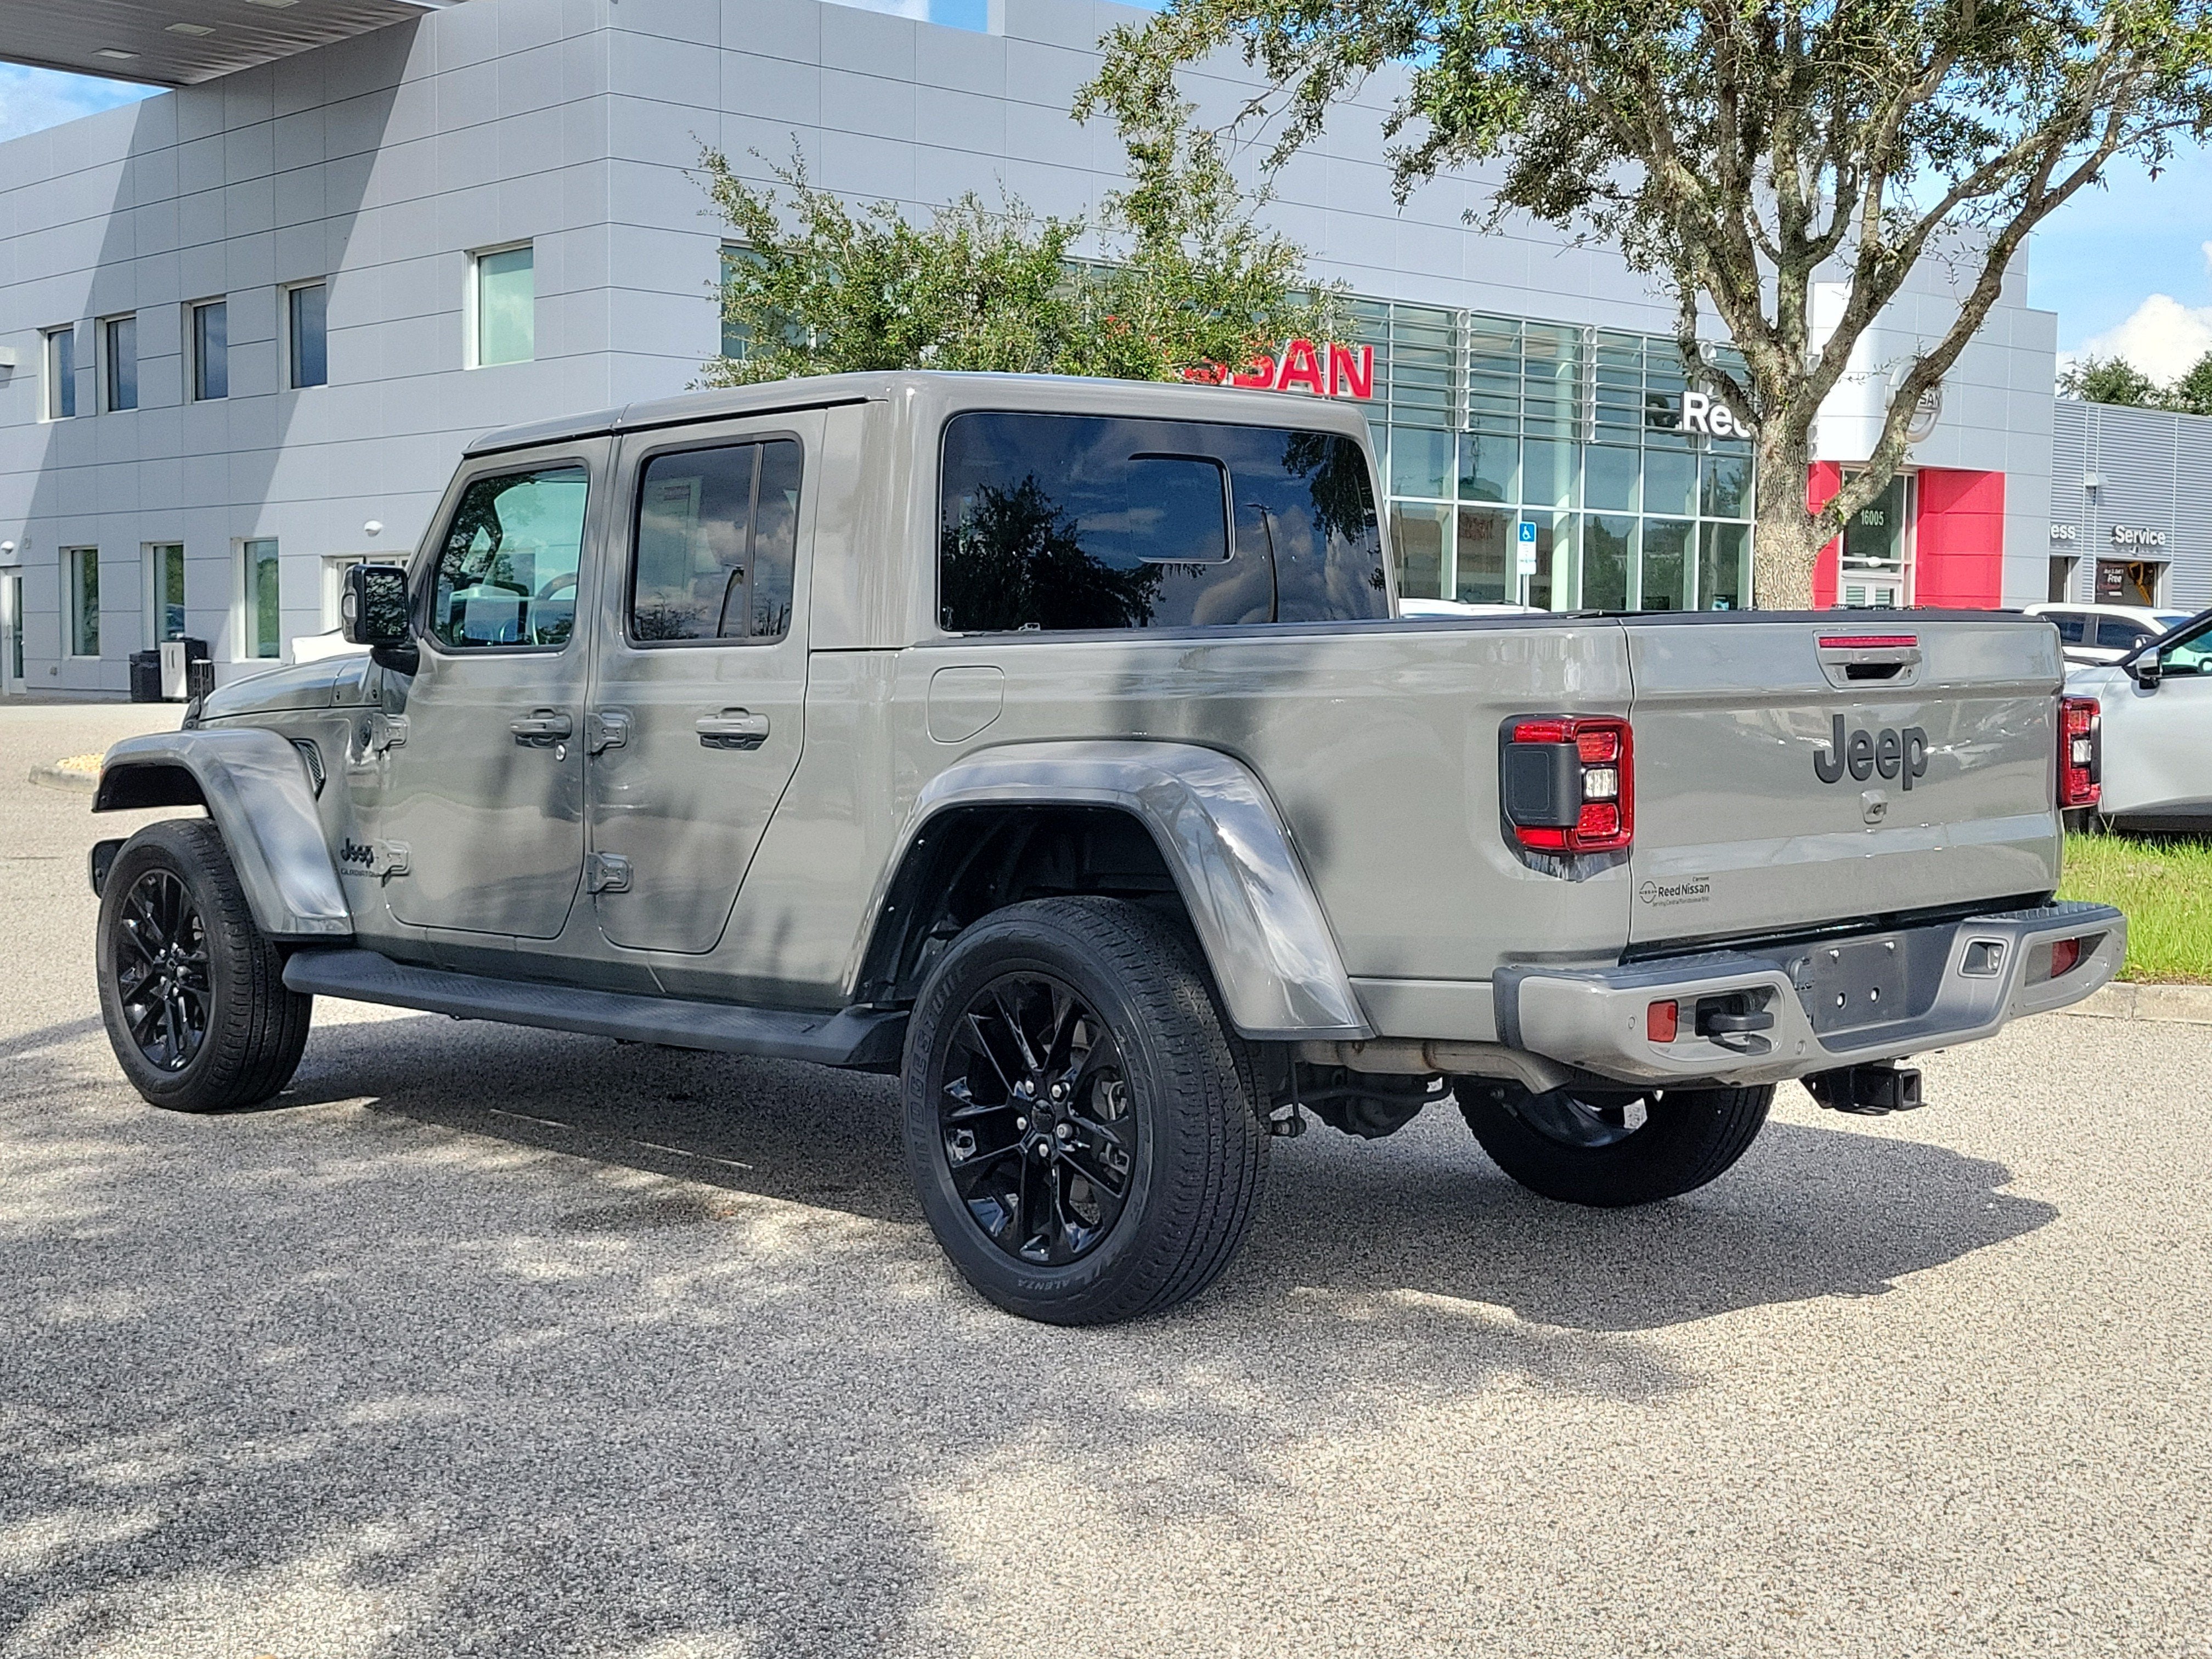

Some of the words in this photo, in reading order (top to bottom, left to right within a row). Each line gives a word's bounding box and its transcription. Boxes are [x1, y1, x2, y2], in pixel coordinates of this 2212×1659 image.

[1860, 509, 1884, 526] 16005
[2050, 524, 2076, 539] ess
[2114, 525, 2166, 545] Service
[1813, 714, 1928, 791] Jeep
[340, 837, 374, 869] Jeep
[1658, 884, 1681, 897] Reed
[1682, 883, 1710, 895] Nissan
[1018, 1279, 1070, 1290] ALENZA
